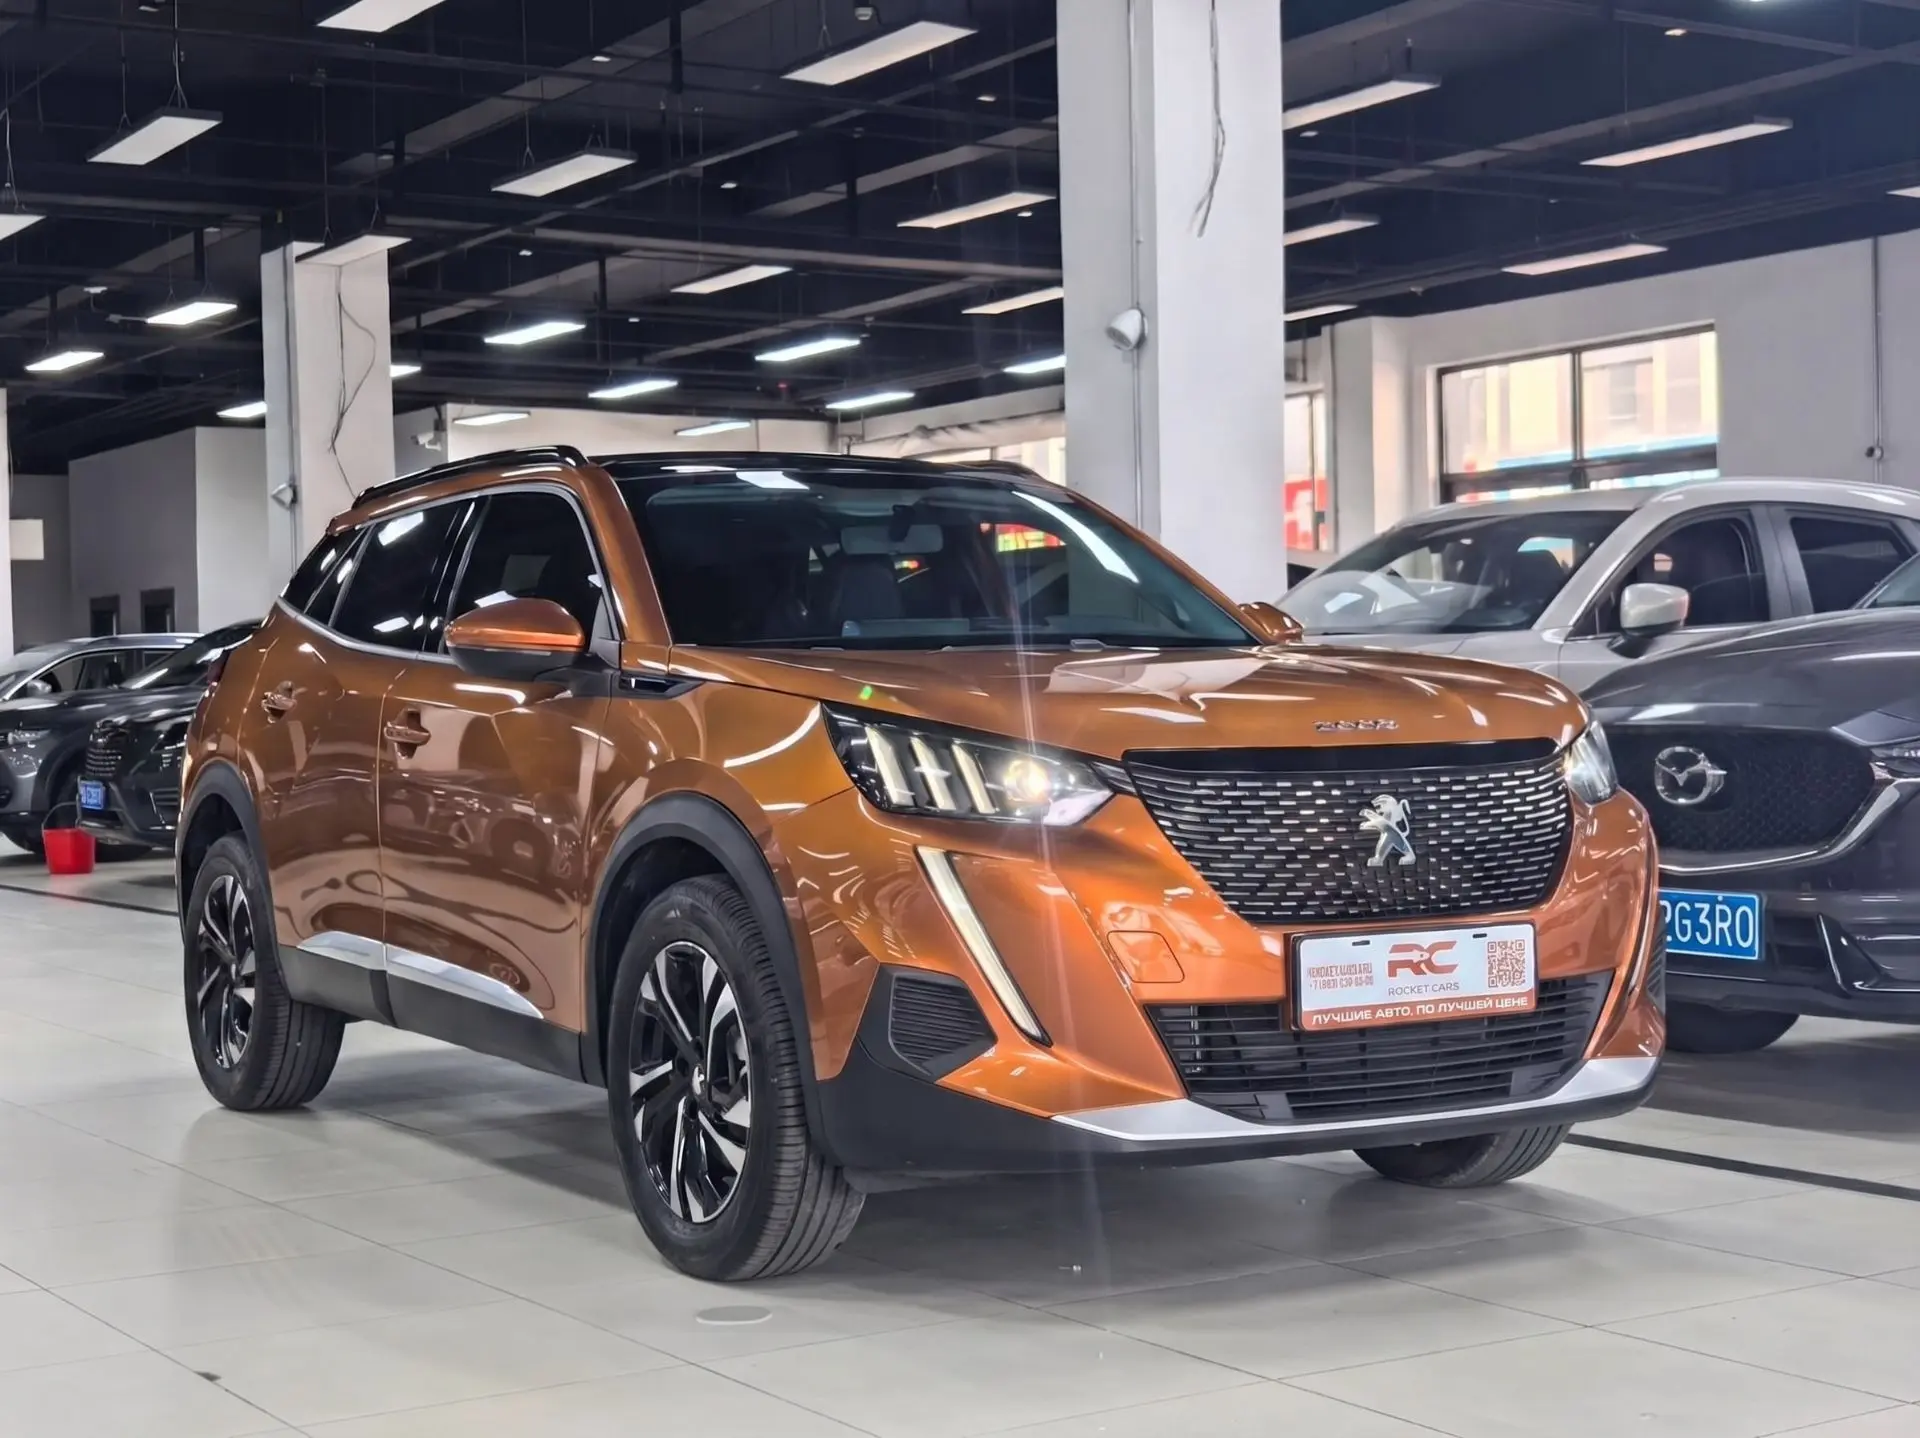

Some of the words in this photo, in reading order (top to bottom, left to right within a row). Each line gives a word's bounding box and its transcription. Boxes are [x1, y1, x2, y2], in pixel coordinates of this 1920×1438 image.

[1388, 941, 1458, 977] RC
[1388, 984, 1429, 996] ROCKET
[1432, 982, 1460, 992] CARS
[1312, 1010, 1372, 1025] ЛУЧШИЕ
[1416, 1004, 1435, 1015] ПО
[1438, 997, 1493, 1013] ЛУЧШЕЙ
[1496, 996, 1528, 1008] ЦЕНЕ
